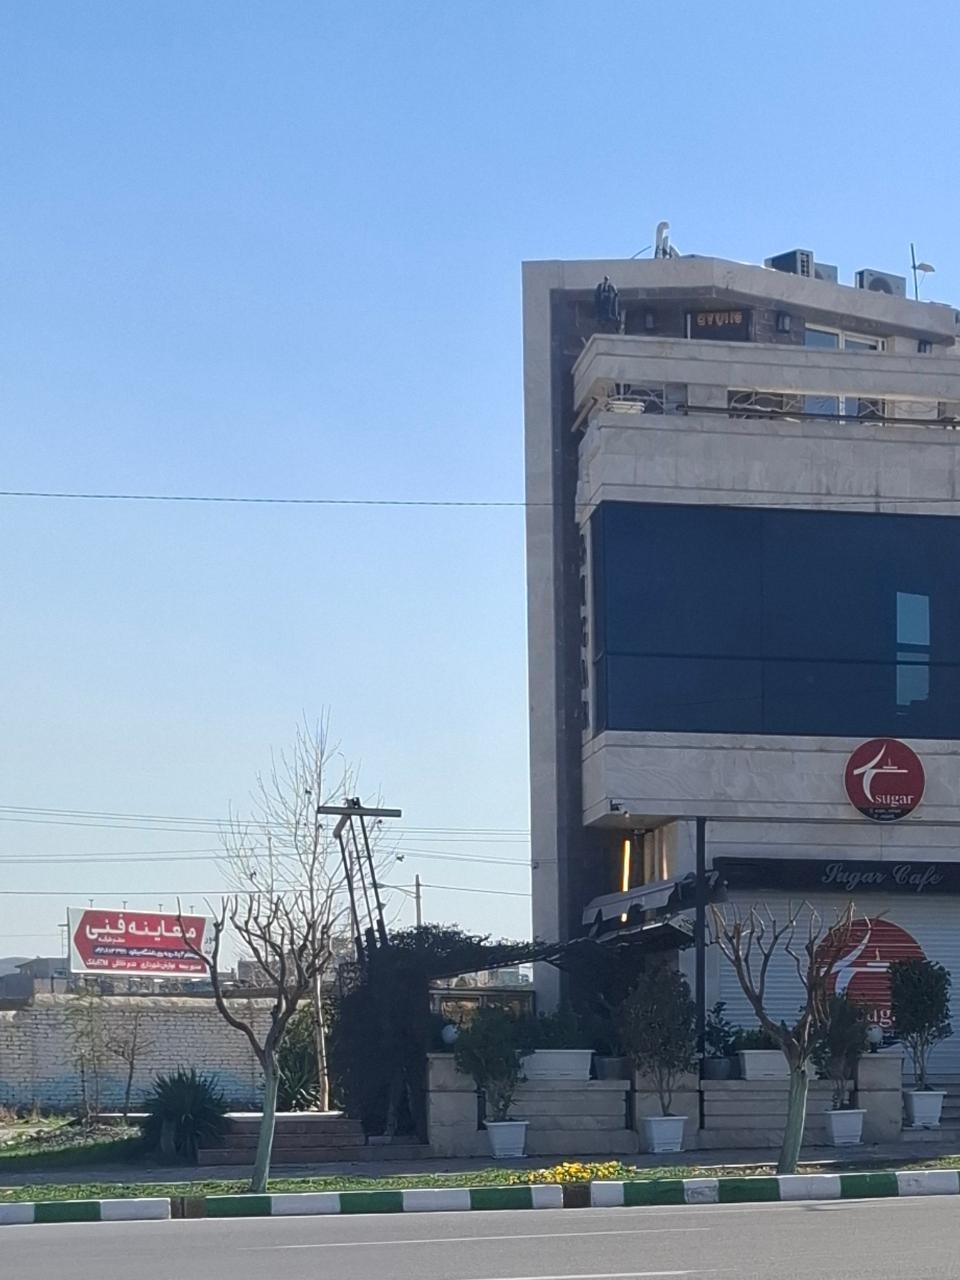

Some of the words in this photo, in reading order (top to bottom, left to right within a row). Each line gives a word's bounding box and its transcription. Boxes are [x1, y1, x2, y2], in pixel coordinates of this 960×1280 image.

[875, 794, 915, 808] sugar
[822, 862, 887, 892] Sugar
[892, 863, 944, 893] Cafe
[86, 914, 126, 939] فنی
[128, 919, 196, 941] معاینه
